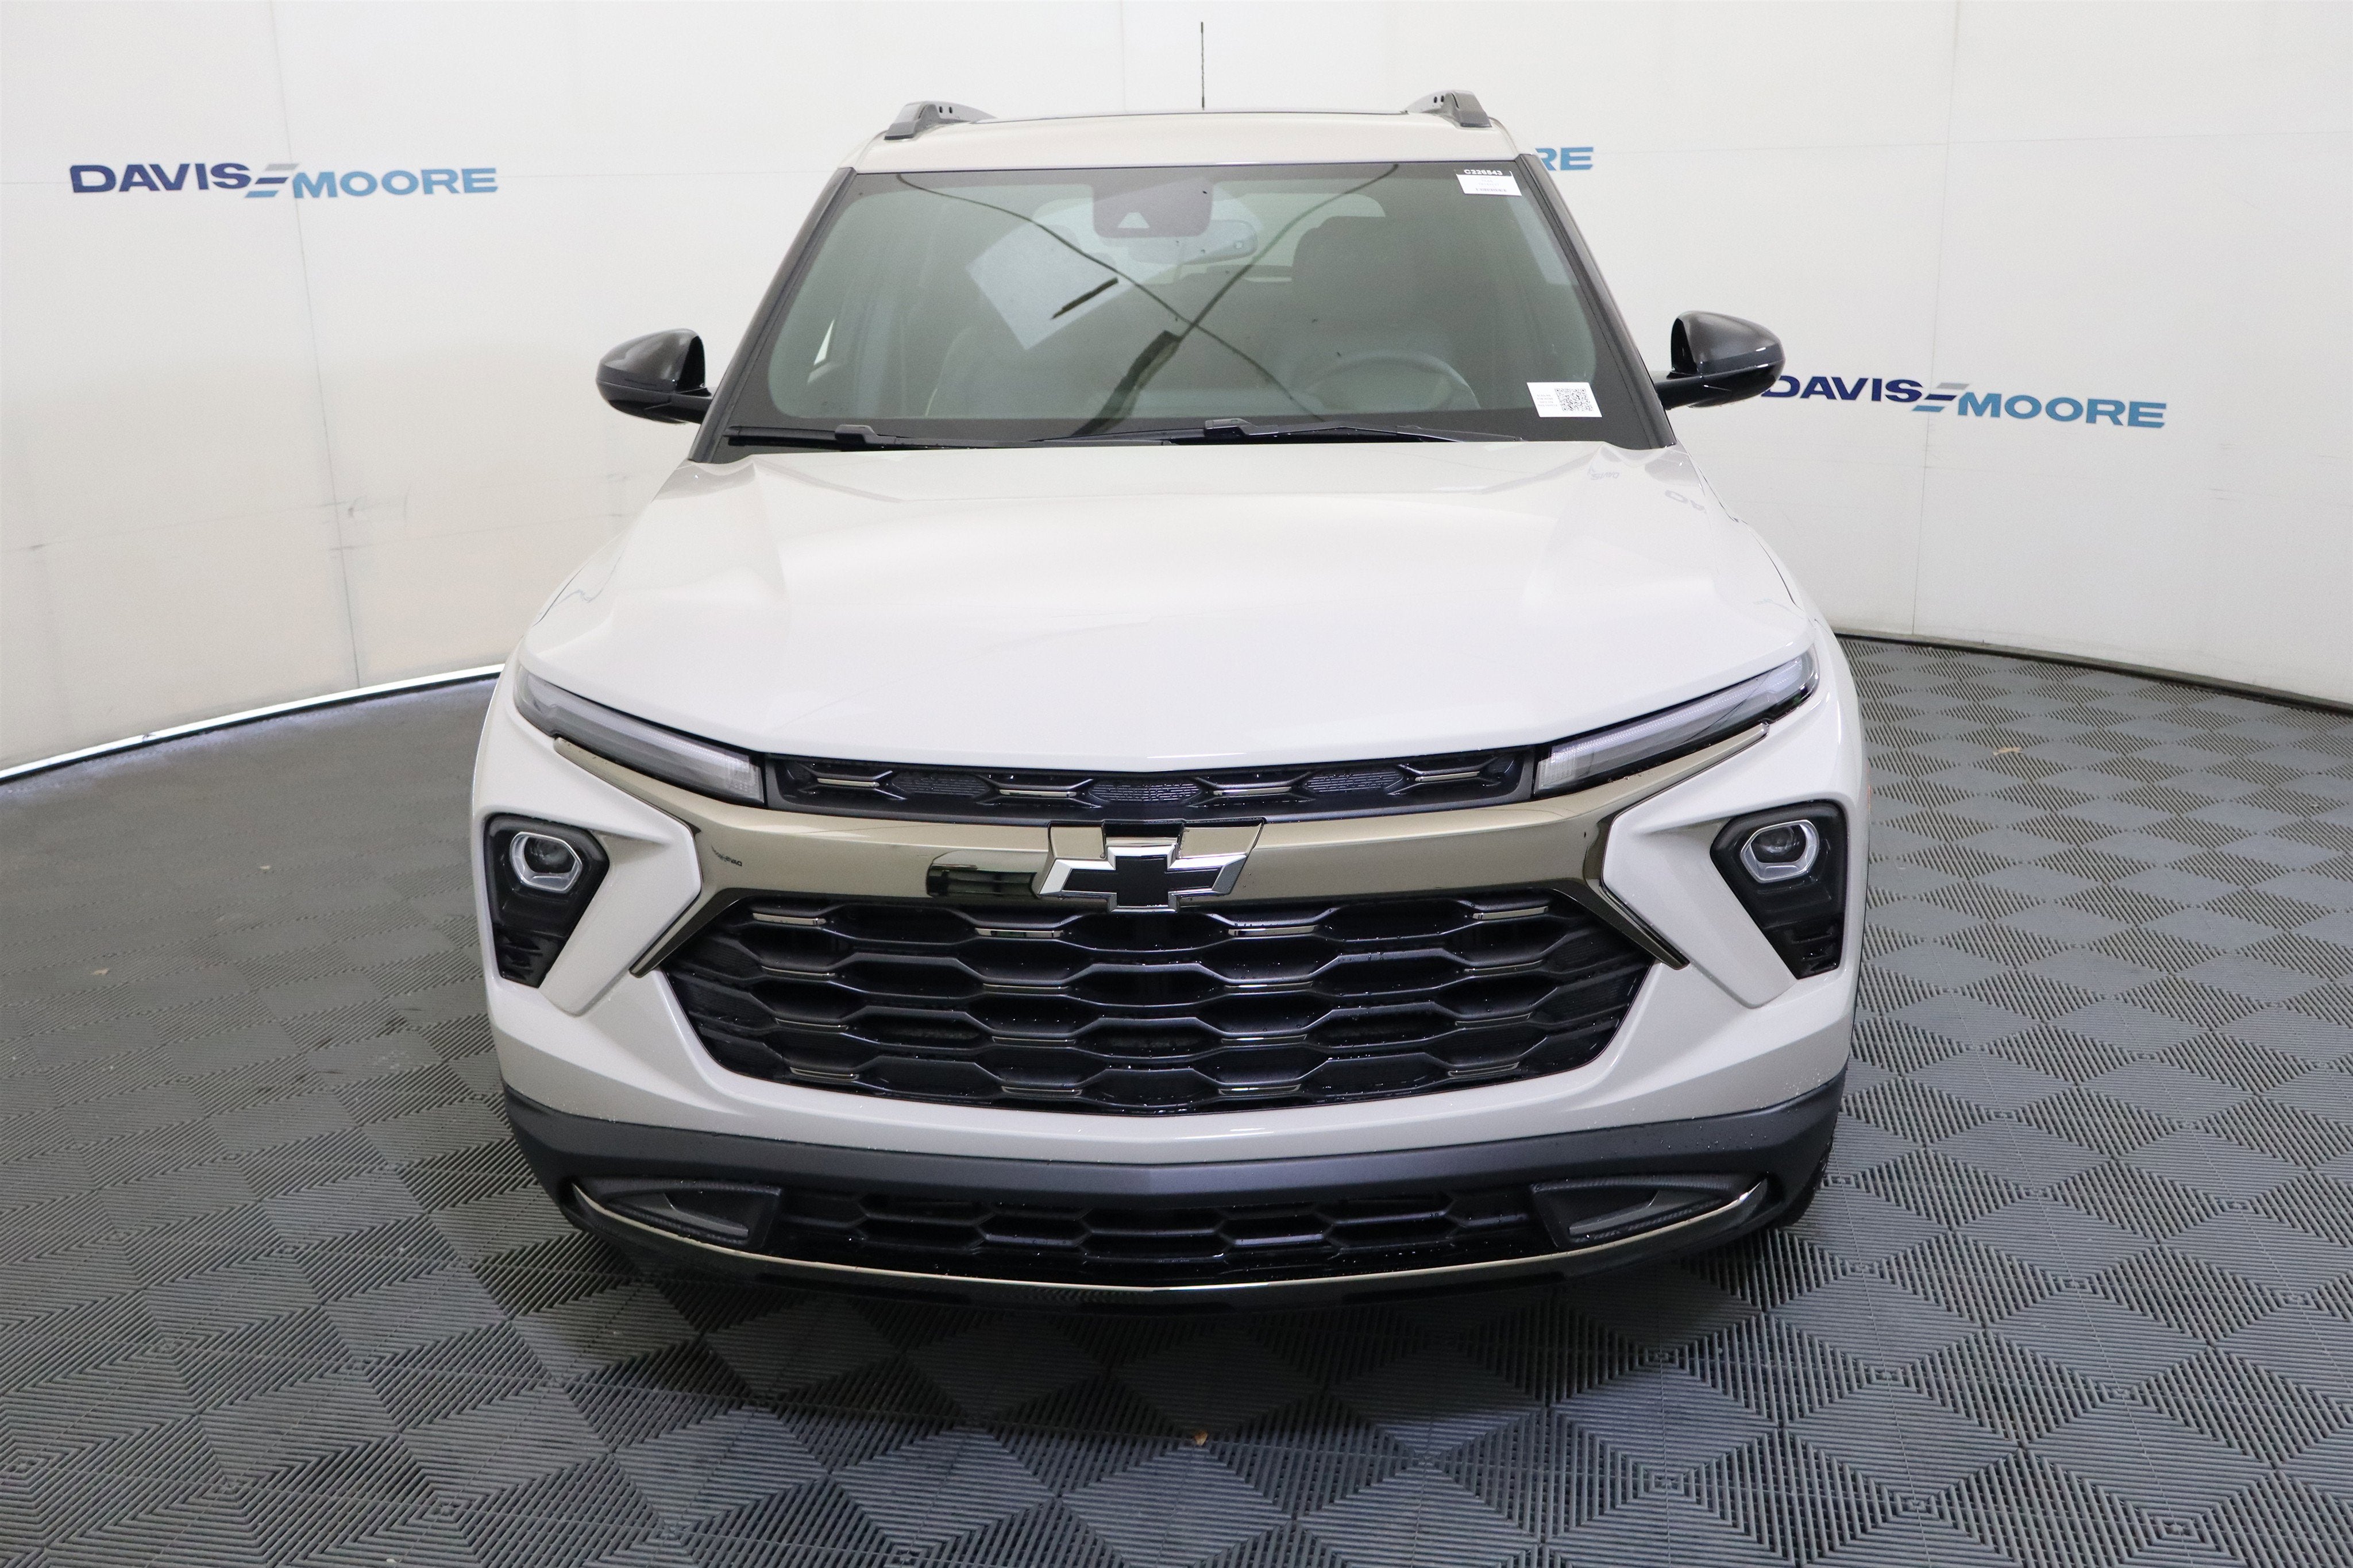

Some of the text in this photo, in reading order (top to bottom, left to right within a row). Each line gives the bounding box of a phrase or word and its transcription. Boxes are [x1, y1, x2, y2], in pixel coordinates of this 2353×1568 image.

[70, 163, 498, 198] DAVIS MOORE
[1761, 375, 2167, 428] DAVIS MOORE
